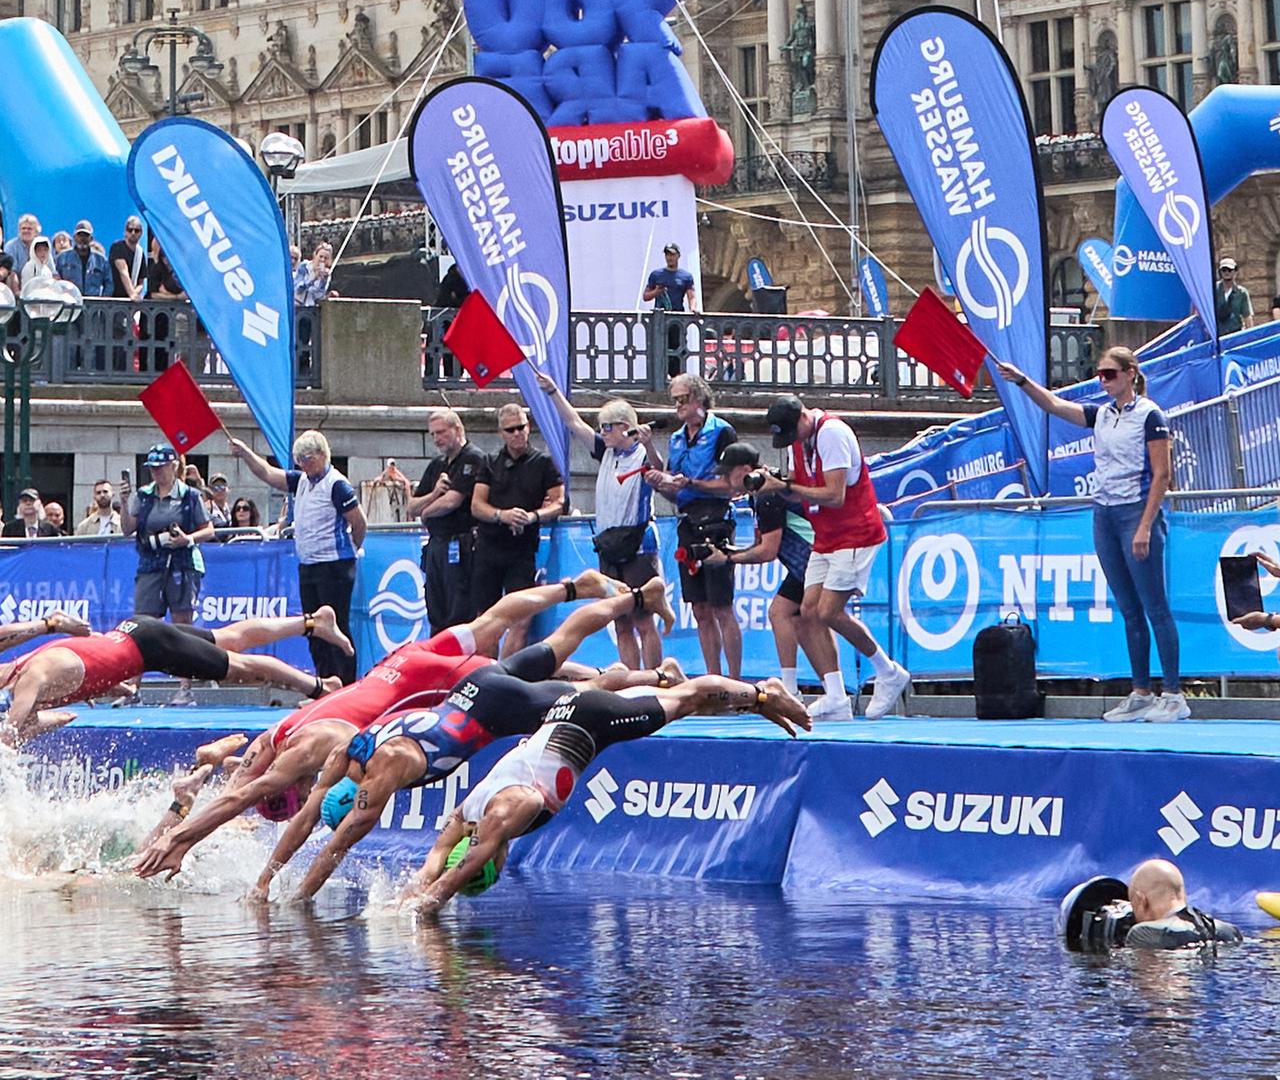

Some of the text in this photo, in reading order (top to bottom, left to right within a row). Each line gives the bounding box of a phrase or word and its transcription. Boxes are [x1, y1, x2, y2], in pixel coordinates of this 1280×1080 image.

[563, 200, 670, 222] SUZUKI
[1138, 261, 1176, 273] WASSE
[946, 450, 1006, 482] HAMBURG
[999, 554, 1113, 623] NTT
[17, 599, 90, 621] SUZUKI
[202, 596, 288, 621] SUZUKI
[622, 779, 757, 821] SUZUKI
[904, 790, 1064, 837] SUZUKI
